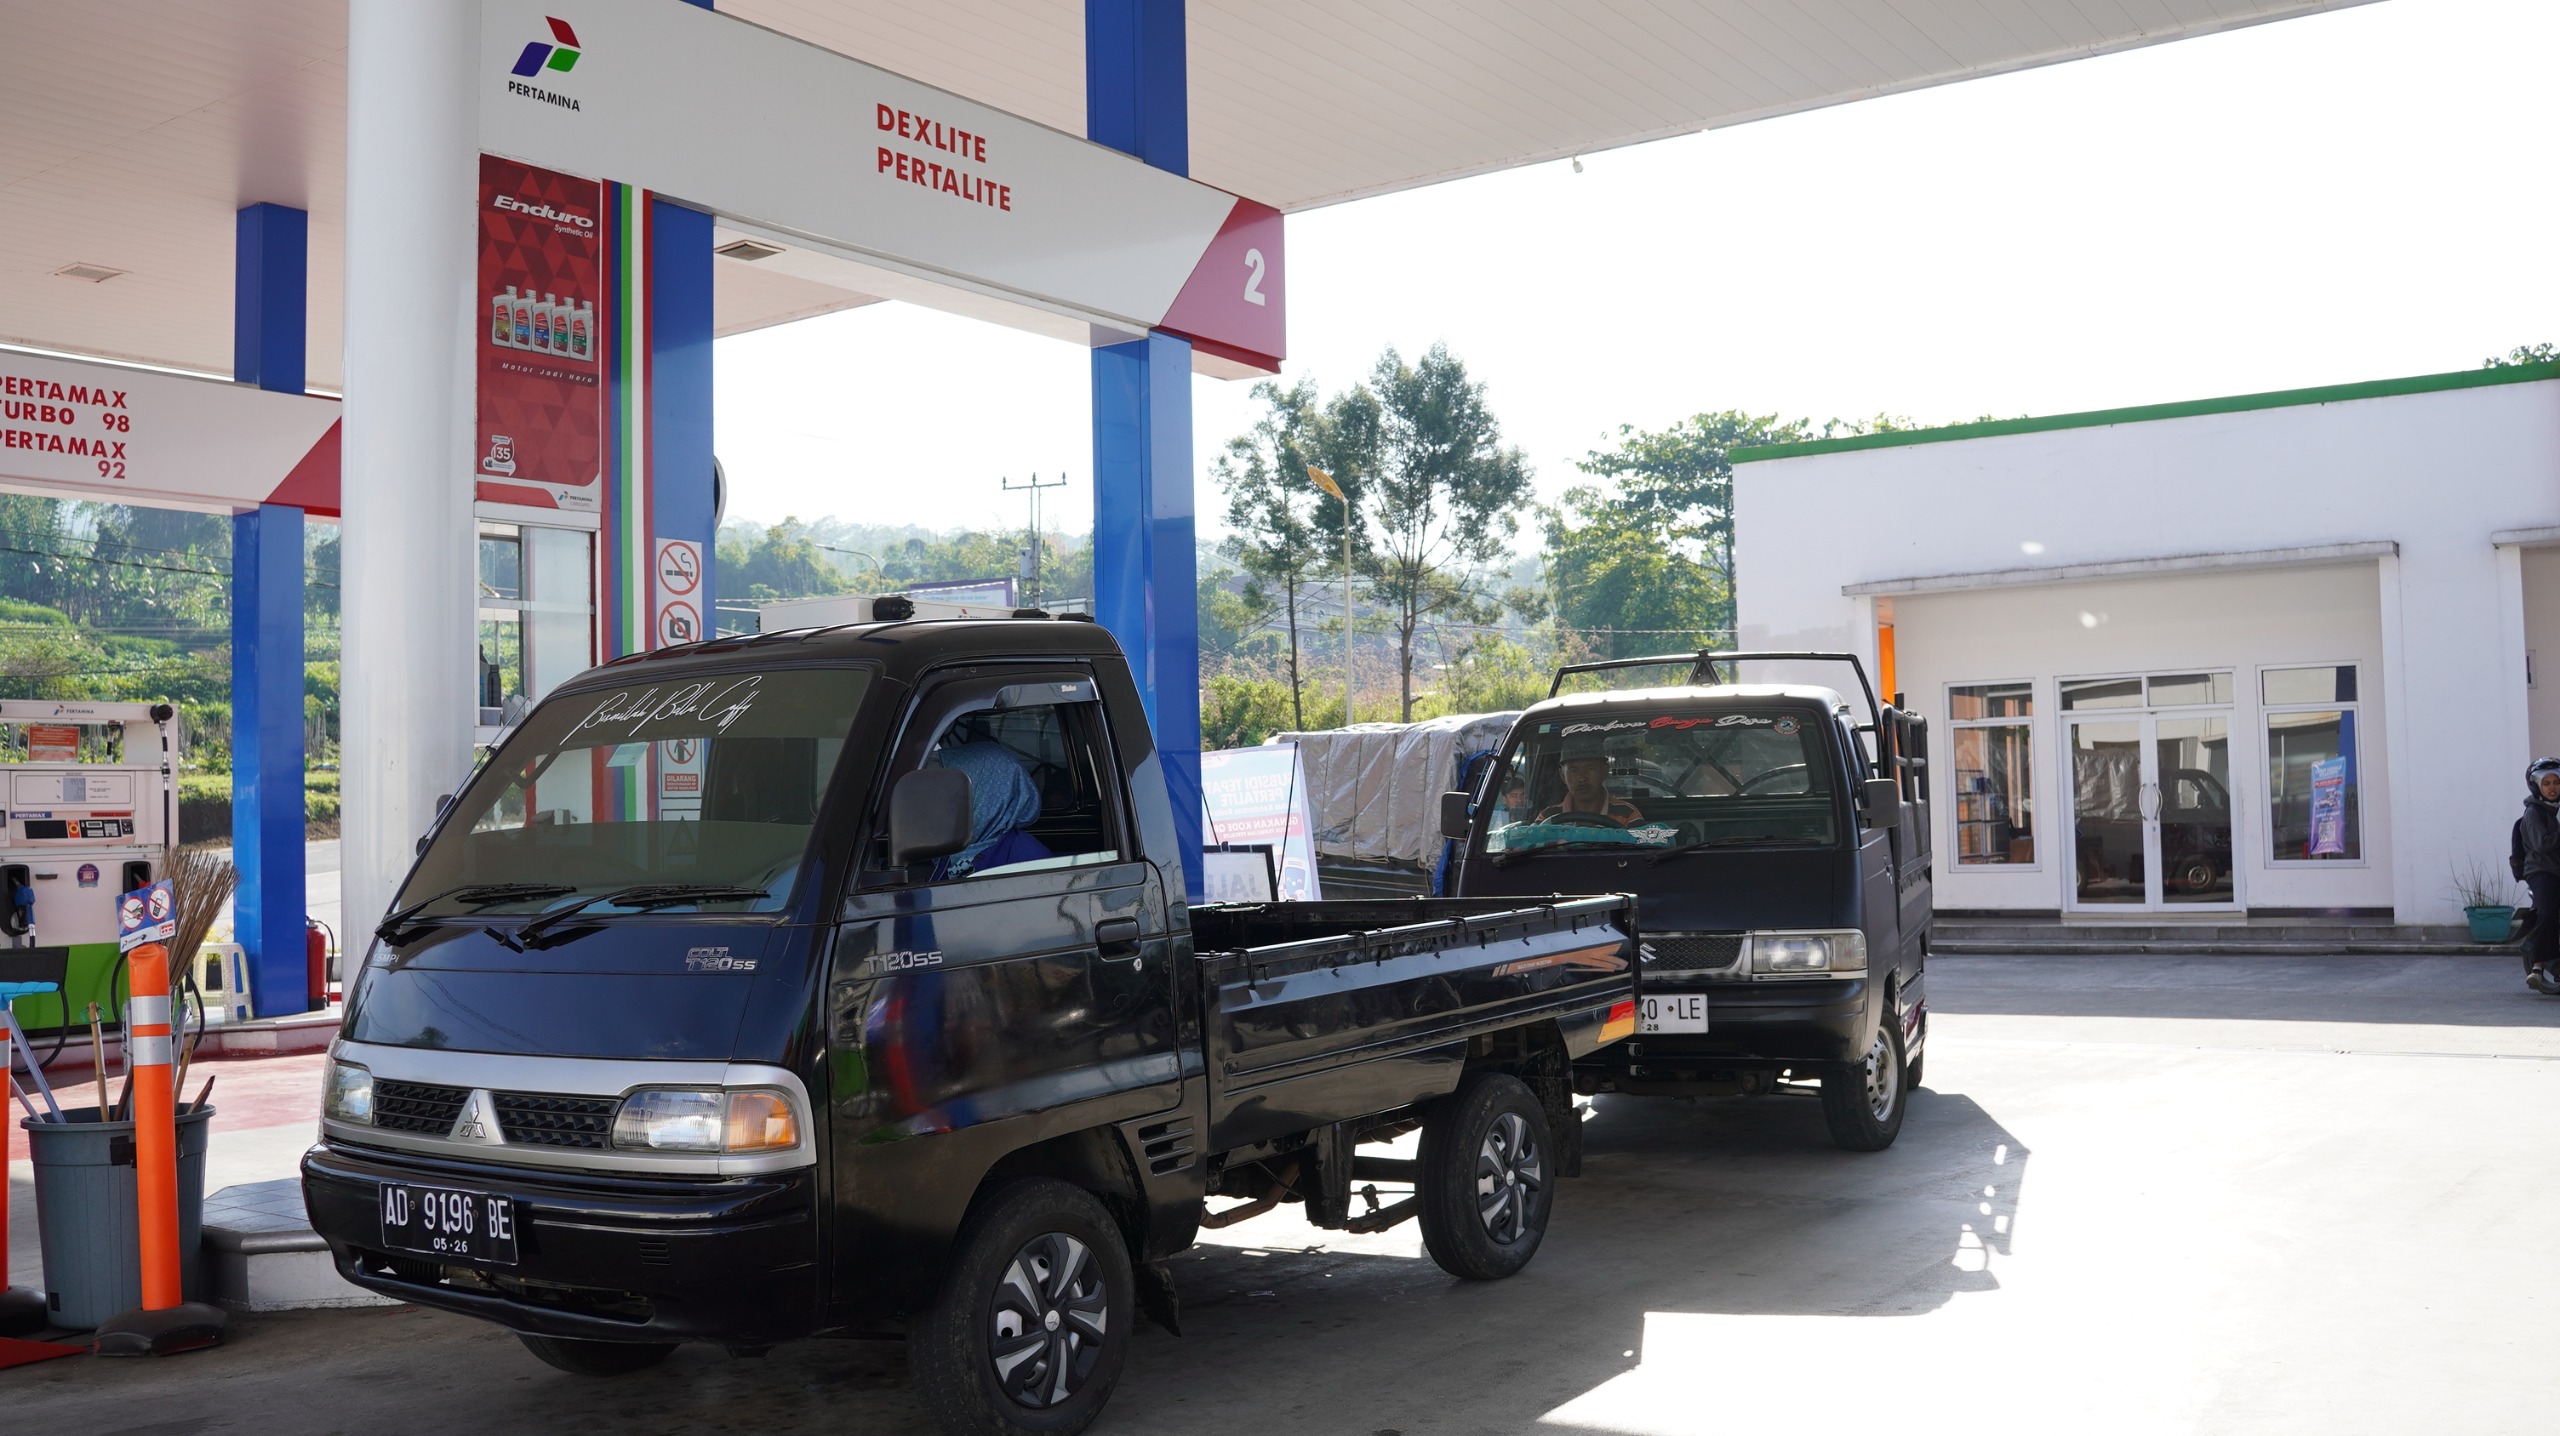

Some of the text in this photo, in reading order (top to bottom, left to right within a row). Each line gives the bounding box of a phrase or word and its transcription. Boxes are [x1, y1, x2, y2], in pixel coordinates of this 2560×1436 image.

[508, 80, 581, 112] PERTAMINA
[877, 102, 986, 163] DEXLITE
[878, 146, 1011, 212] PERTALITE
[493, 194, 594, 228] Enduro
[554, 223, 593, 239] Synthetic Oil
[1244, 247, 1266, 307] 2
[501, 362, 534, 373] Motor
[568, 374, 593, 383] Hero
[0, 375, 127, 410] ERTAMAX
[0, 399, 130, 433] URBO 98
[0, 429, 127, 460] ERTAMAX
[98, 460, 125, 480] 92
[687, 946, 729, 958] COLT
[863, 950, 944, 975] T120SS
[1677, 997, 1701, 1020] LE
[386, 1187, 511, 1240] AD 9196 BE
